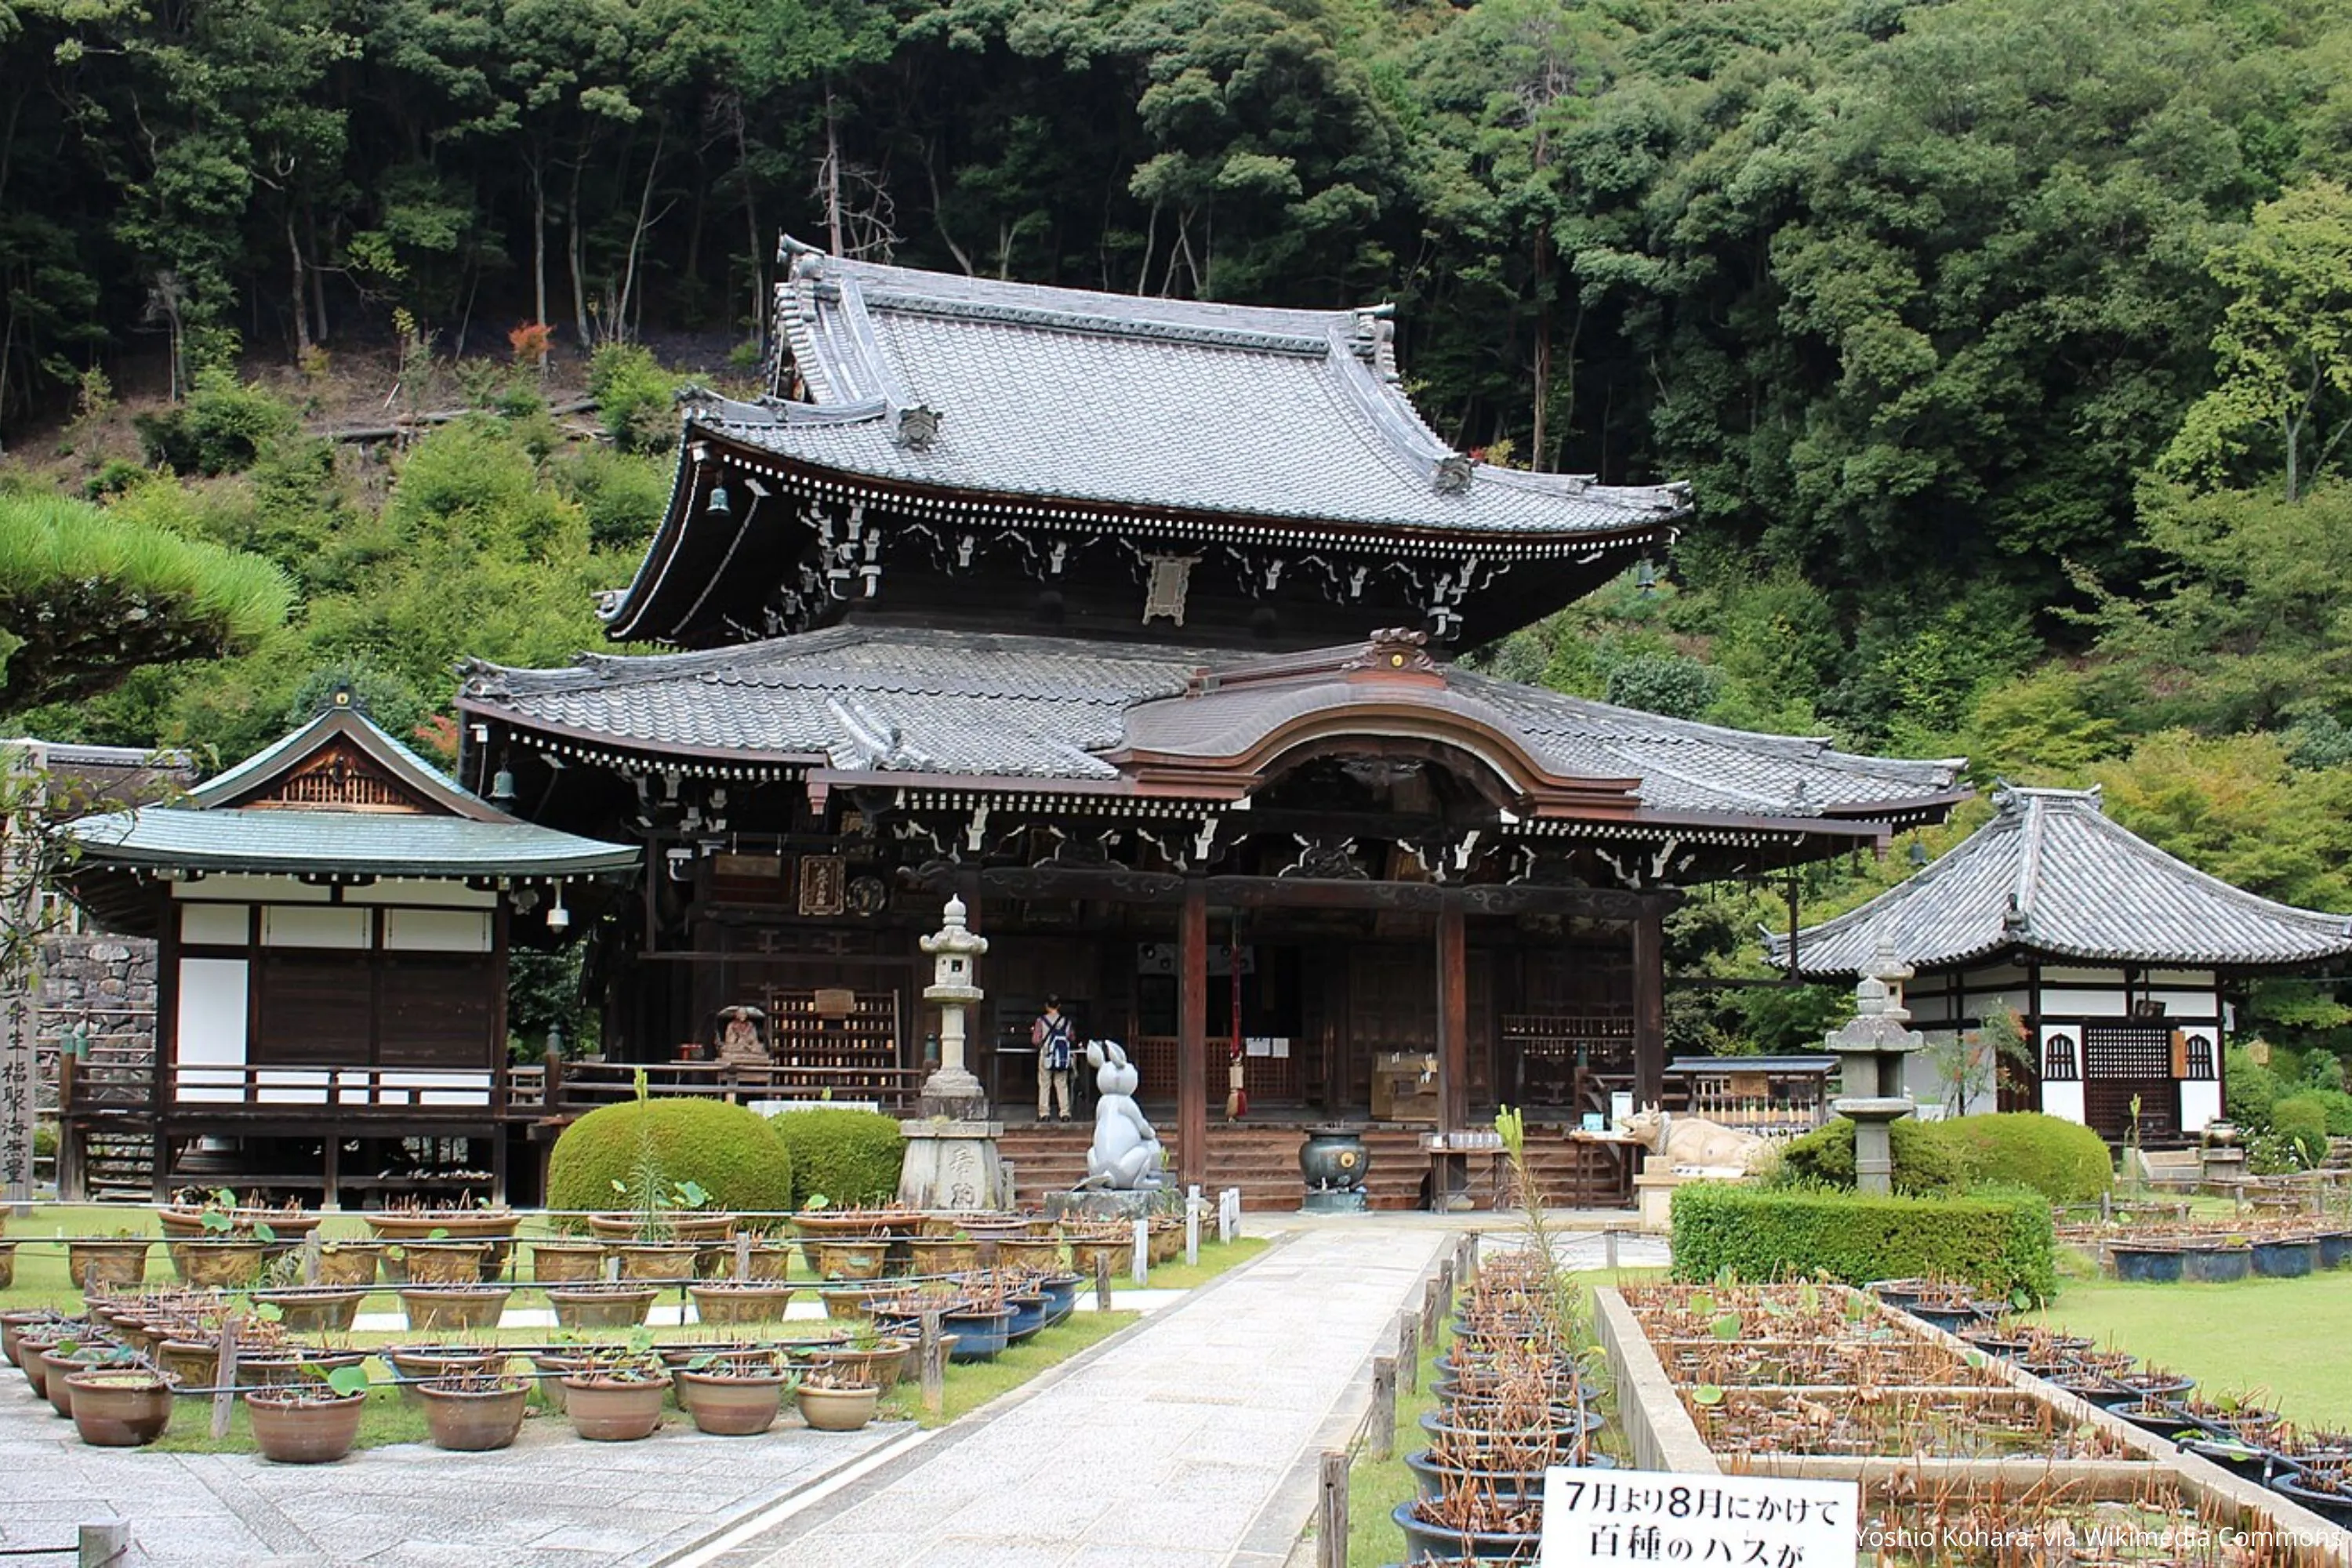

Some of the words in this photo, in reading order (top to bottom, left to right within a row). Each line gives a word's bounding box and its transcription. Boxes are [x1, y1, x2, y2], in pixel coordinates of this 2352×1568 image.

[1565, 1481, 1839, 1526] 7月より8月にかけて
[1588, 1523, 1805, 1568] 百種のハスが
